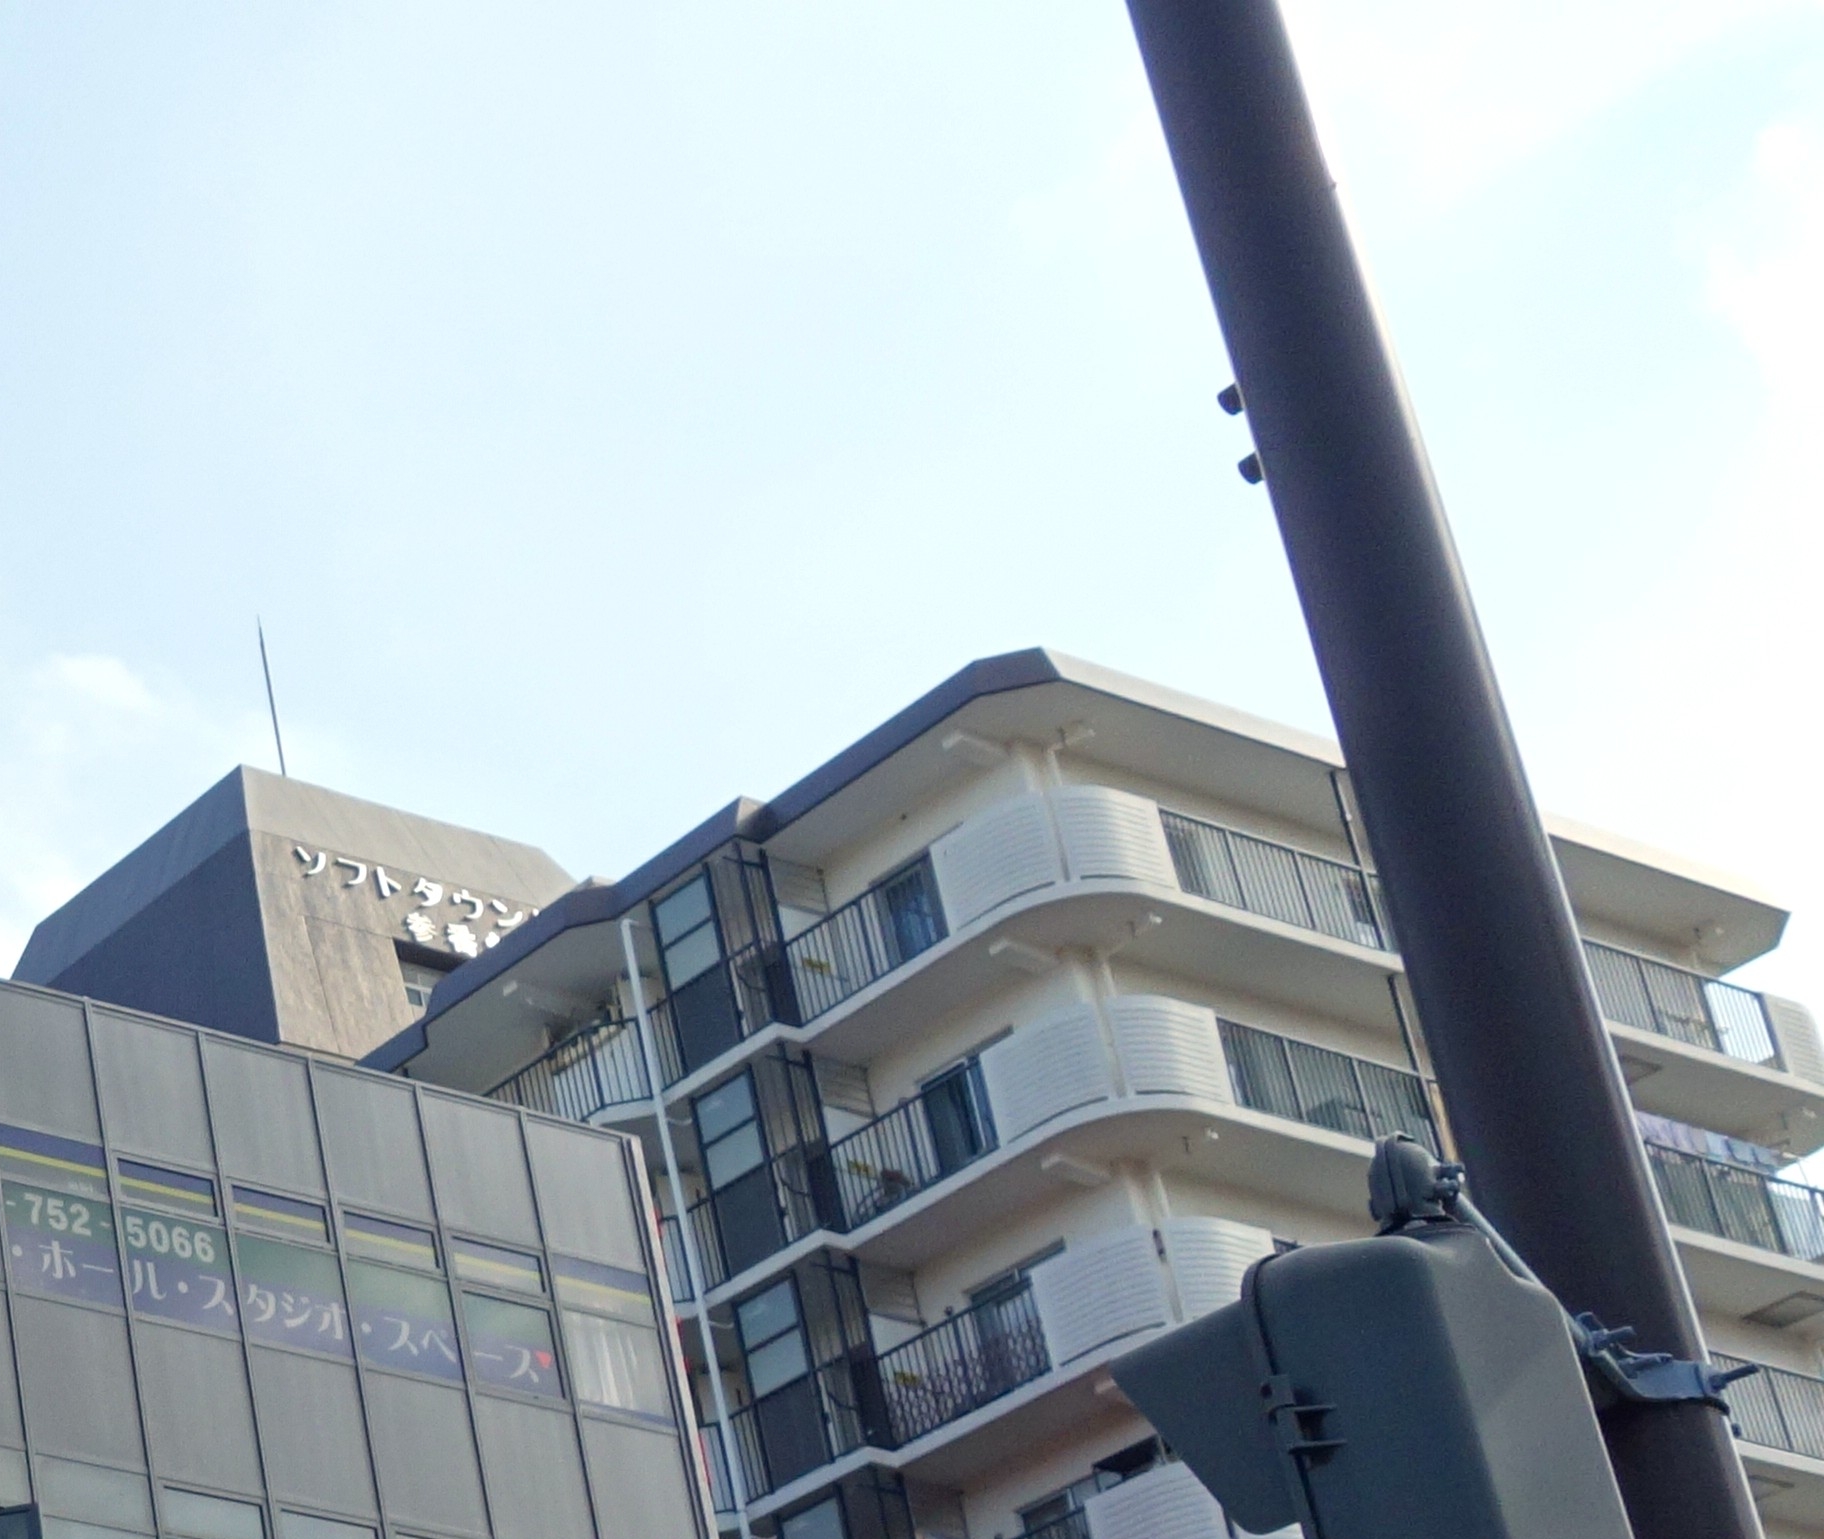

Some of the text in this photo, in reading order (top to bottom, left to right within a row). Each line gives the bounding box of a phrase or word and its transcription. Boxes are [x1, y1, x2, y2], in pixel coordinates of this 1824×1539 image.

[295, 845, 540, 928] ソフトタウン
